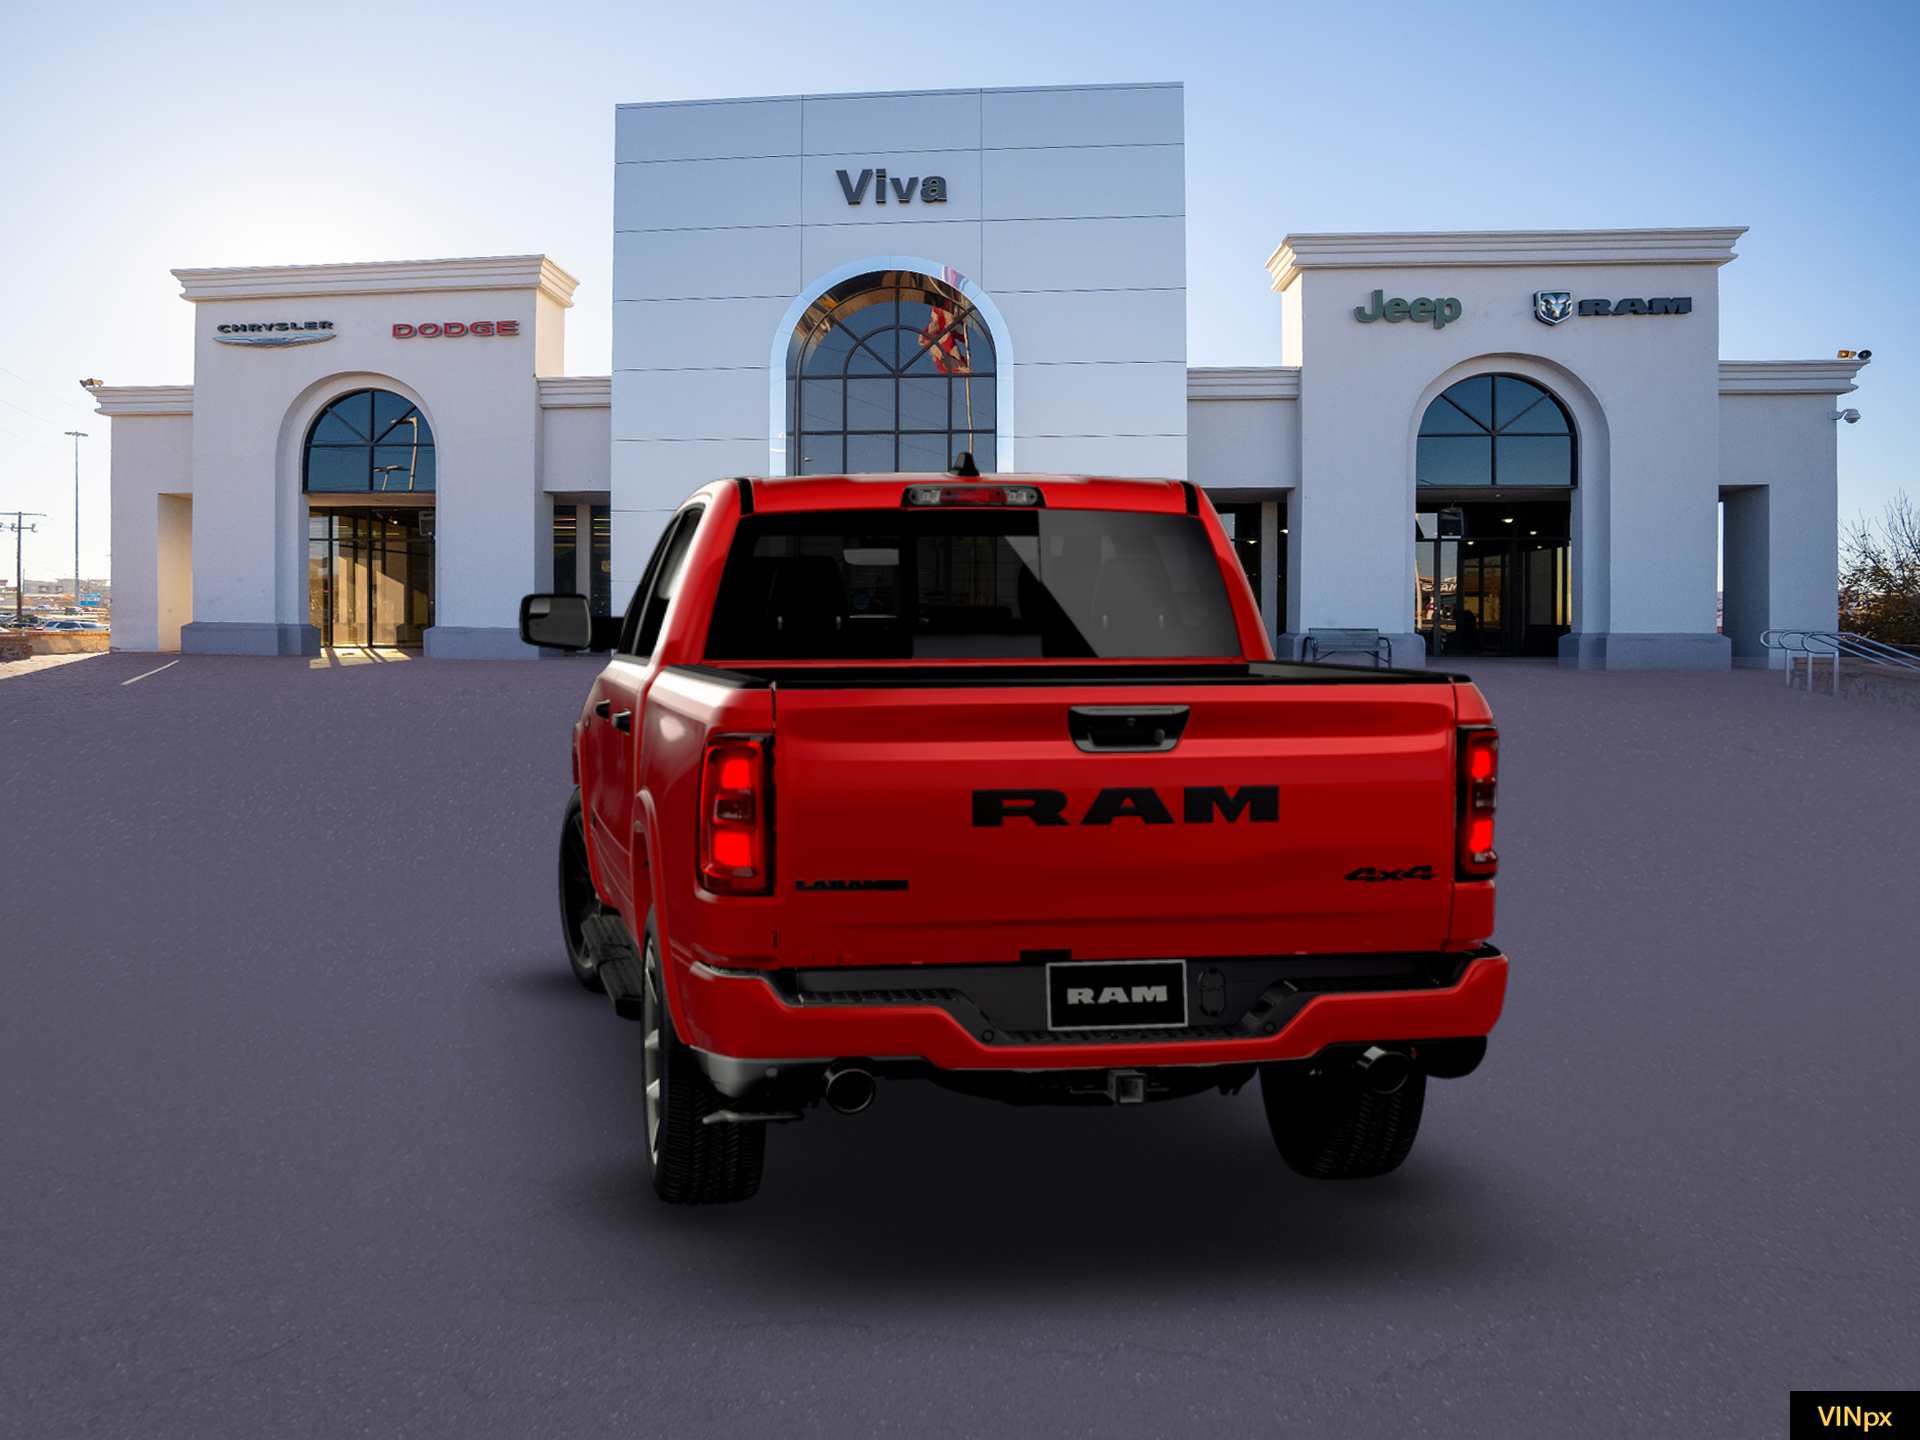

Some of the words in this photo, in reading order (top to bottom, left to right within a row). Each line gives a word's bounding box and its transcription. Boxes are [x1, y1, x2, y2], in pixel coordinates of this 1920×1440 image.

[835, 168, 947, 205] Viva
[1354, 289, 1462, 329] Jeep
[1578, 297, 1692, 316] RAM
[217, 321, 334, 333] CHRYSLER
[392, 320, 519, 338] DODGE
[972, 785, 1279, 827] RAM
[1342, 865, 1437, 882] 4x4
[795, 880, 909, 891] LARAM
[1067, 985, 1168, 1004] RAM
